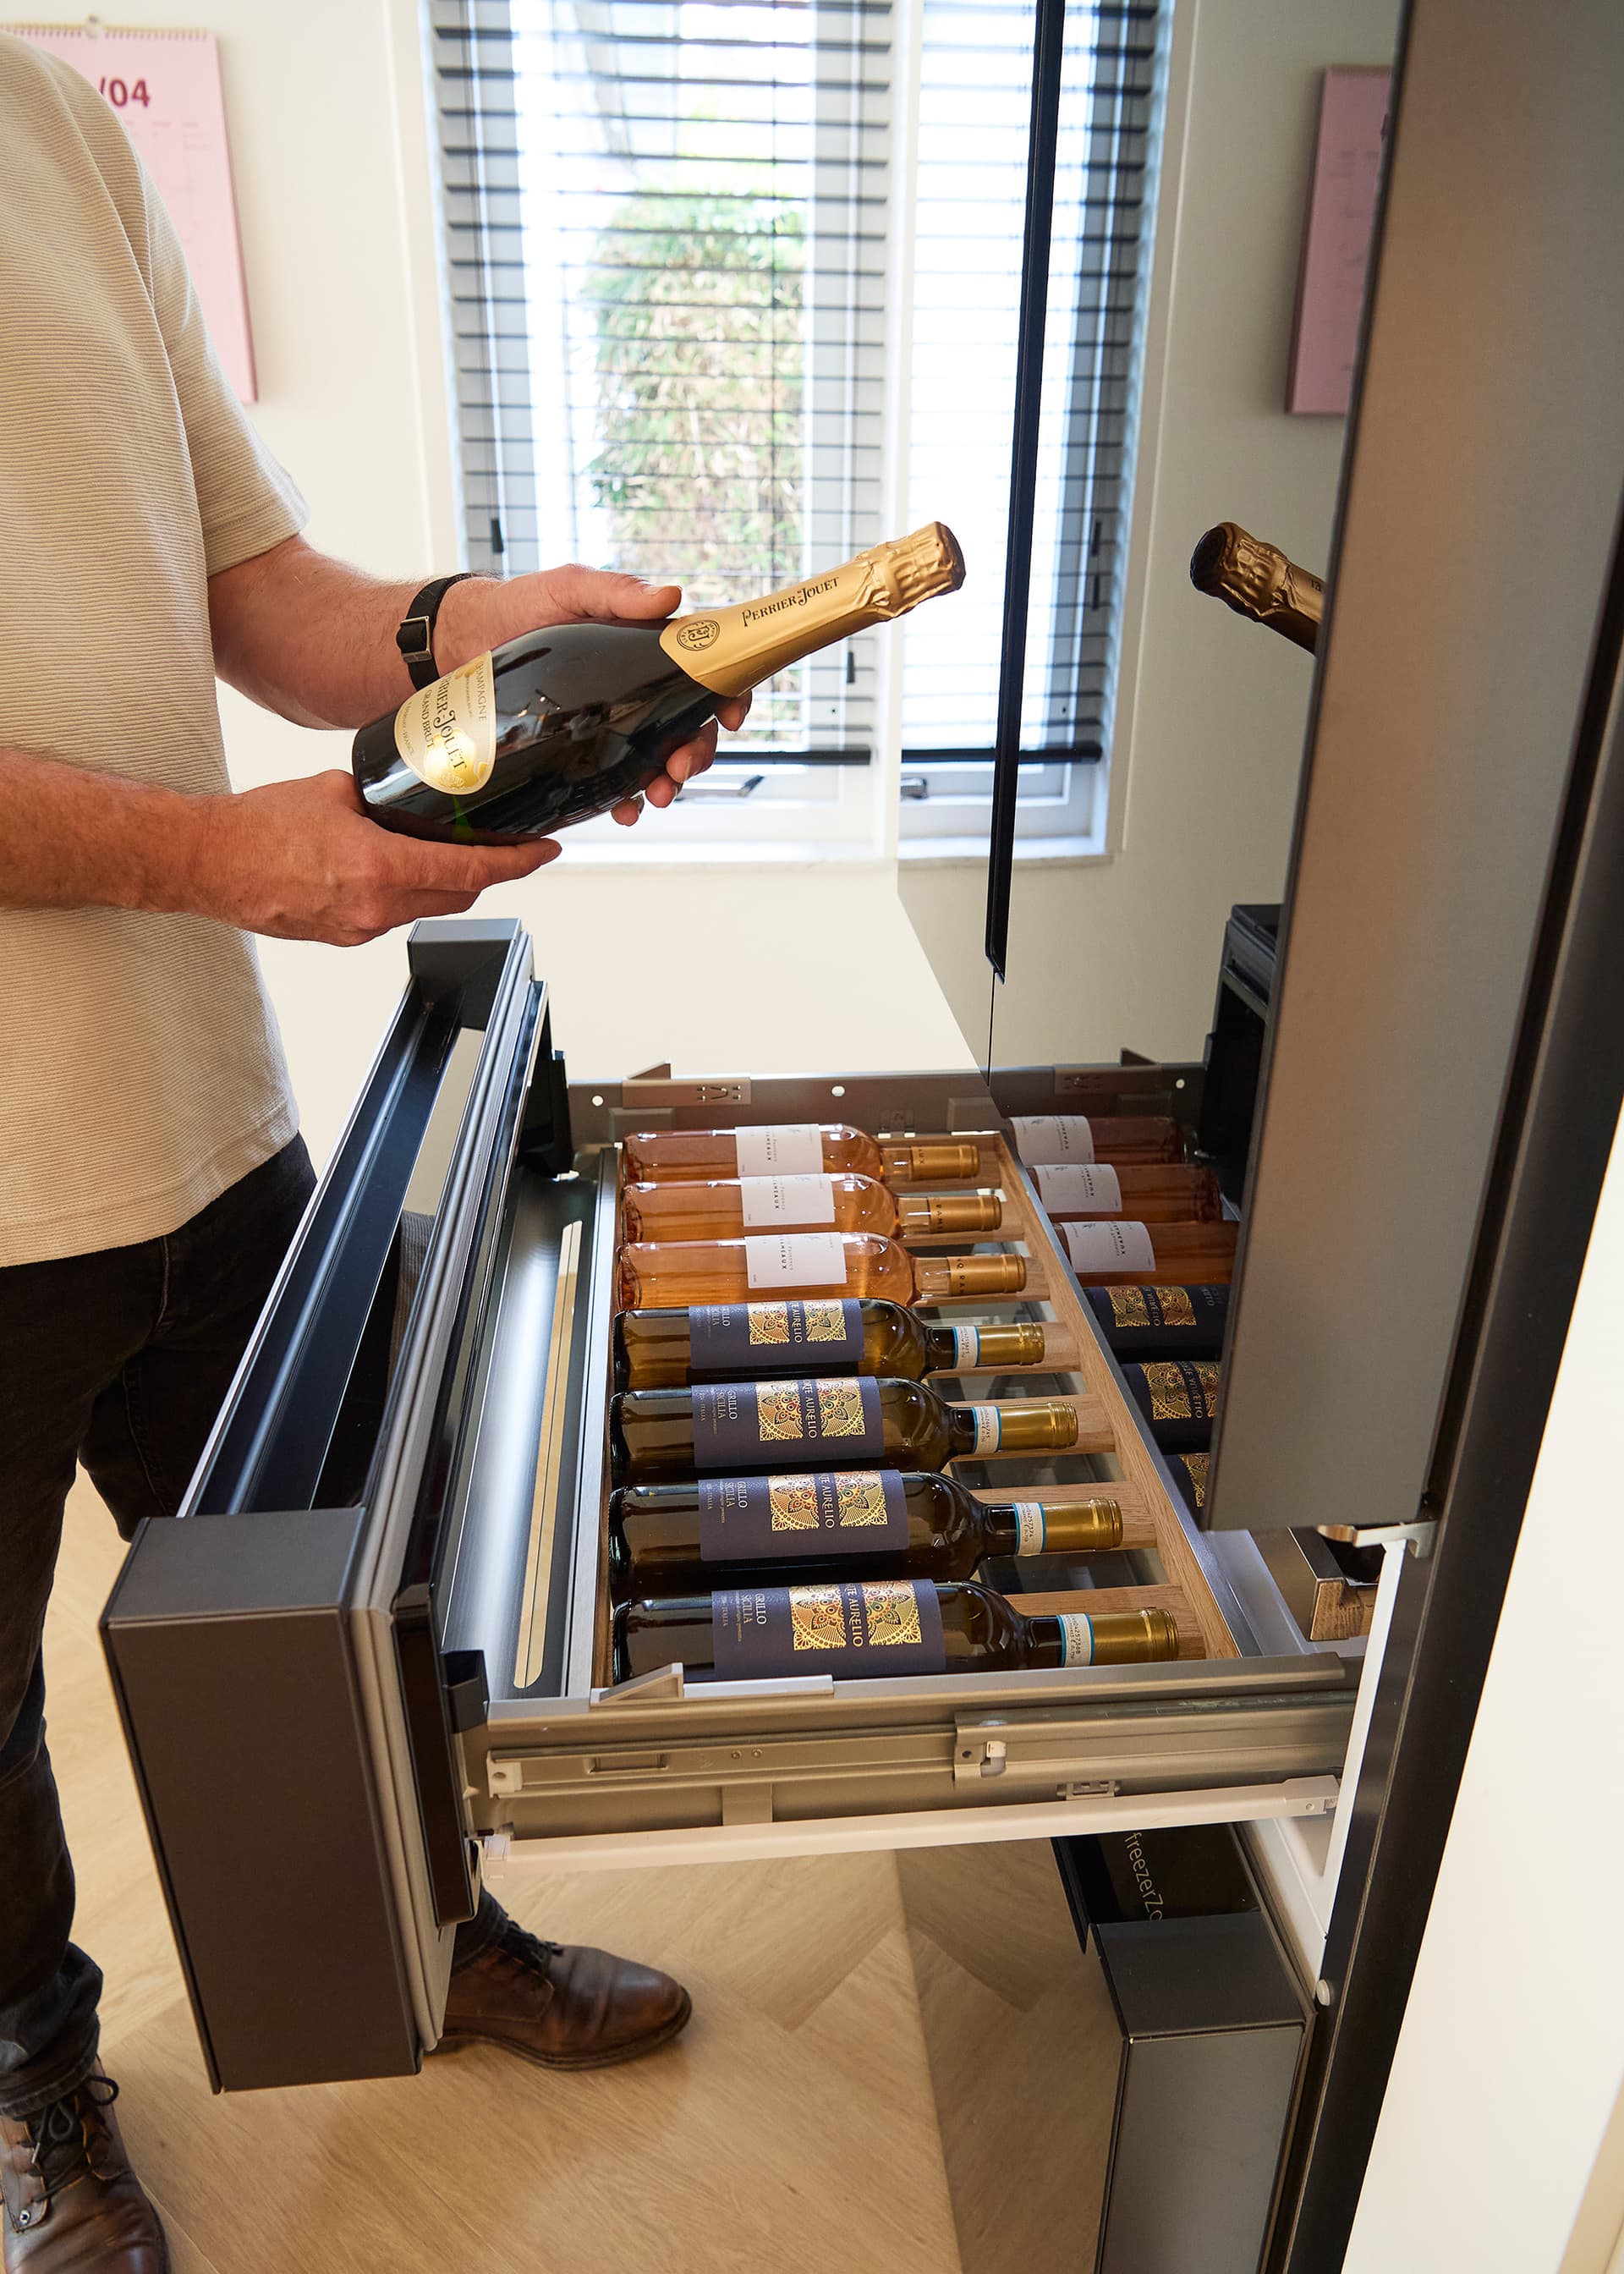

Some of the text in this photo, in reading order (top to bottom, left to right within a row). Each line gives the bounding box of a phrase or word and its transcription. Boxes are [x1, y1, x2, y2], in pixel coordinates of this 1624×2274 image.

[422, 722, 436, 748] BRUT
[792, 1310, 803, 1343] AURELIO
[717, 1392, 726, 1420] SICILIA
[727, 1391, 738, 1420] GRILLO
[805, 1397, 818, 1439] AURELIO
[725, 1481, 735, 1508] SICILIA
[737, 1481, 749, 1508] GRILLO
[822, 1486, 836, 1529] AURELIO
[741, 1594, 754, 1624] SICILIA
[754, 1593, 767, 1625] GRILLO
[848, 1598, 864, 1648] AURELIO
[1124, 1832, 1164, 1921] freezerZo
